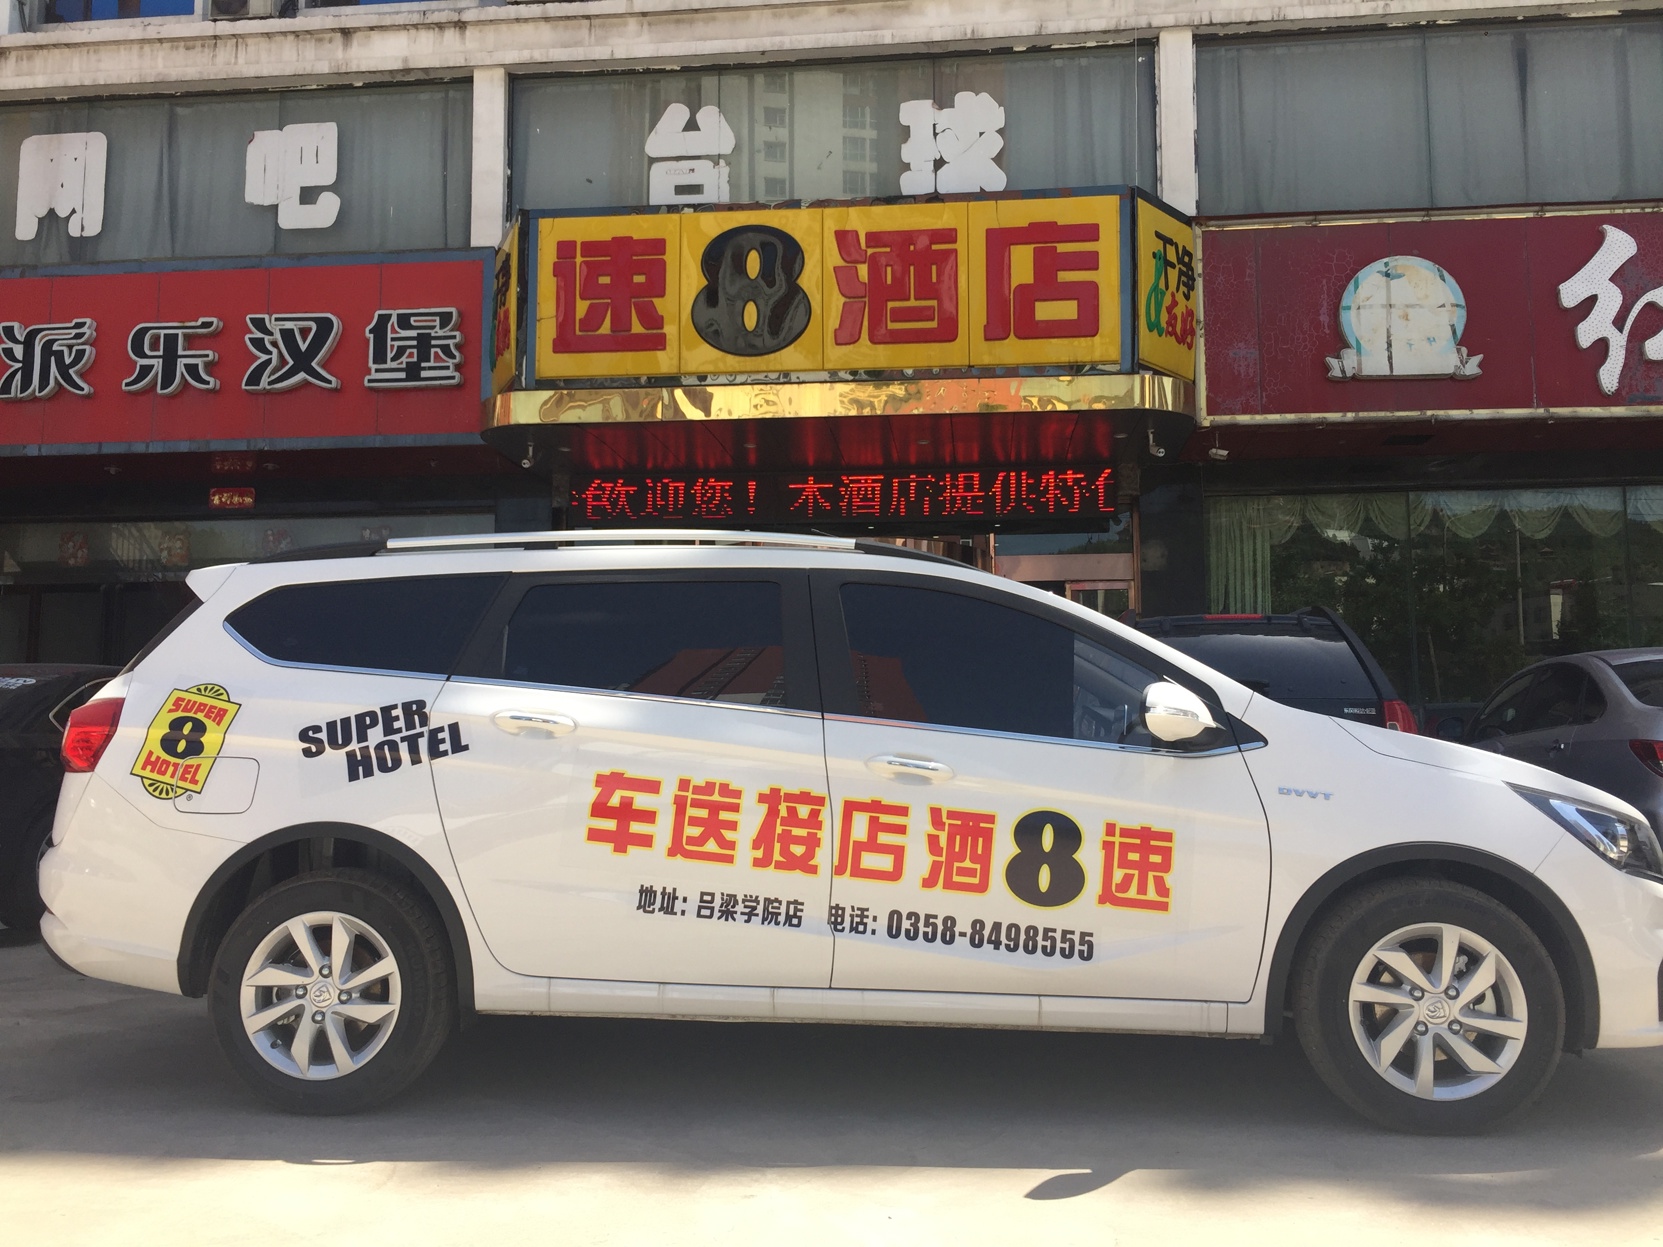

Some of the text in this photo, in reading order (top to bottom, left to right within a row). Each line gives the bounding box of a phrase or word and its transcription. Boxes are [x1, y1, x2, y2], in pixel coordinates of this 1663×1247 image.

[15, 122, 341, 240] 网吧
[552, 221, 1101, 355] 速8酒店
[0, 307, 463, 400] 派乐汉堡
[160, 716, 207, 760] 8
[167, 696, 229, 727] SUPER
[298, 699, 429, 758] SUPER
[140, 749, 202, 786] HOTEL
[345, 721, 470, 783] HOTEL
[1278, 786, 1334, 801] DVVT
